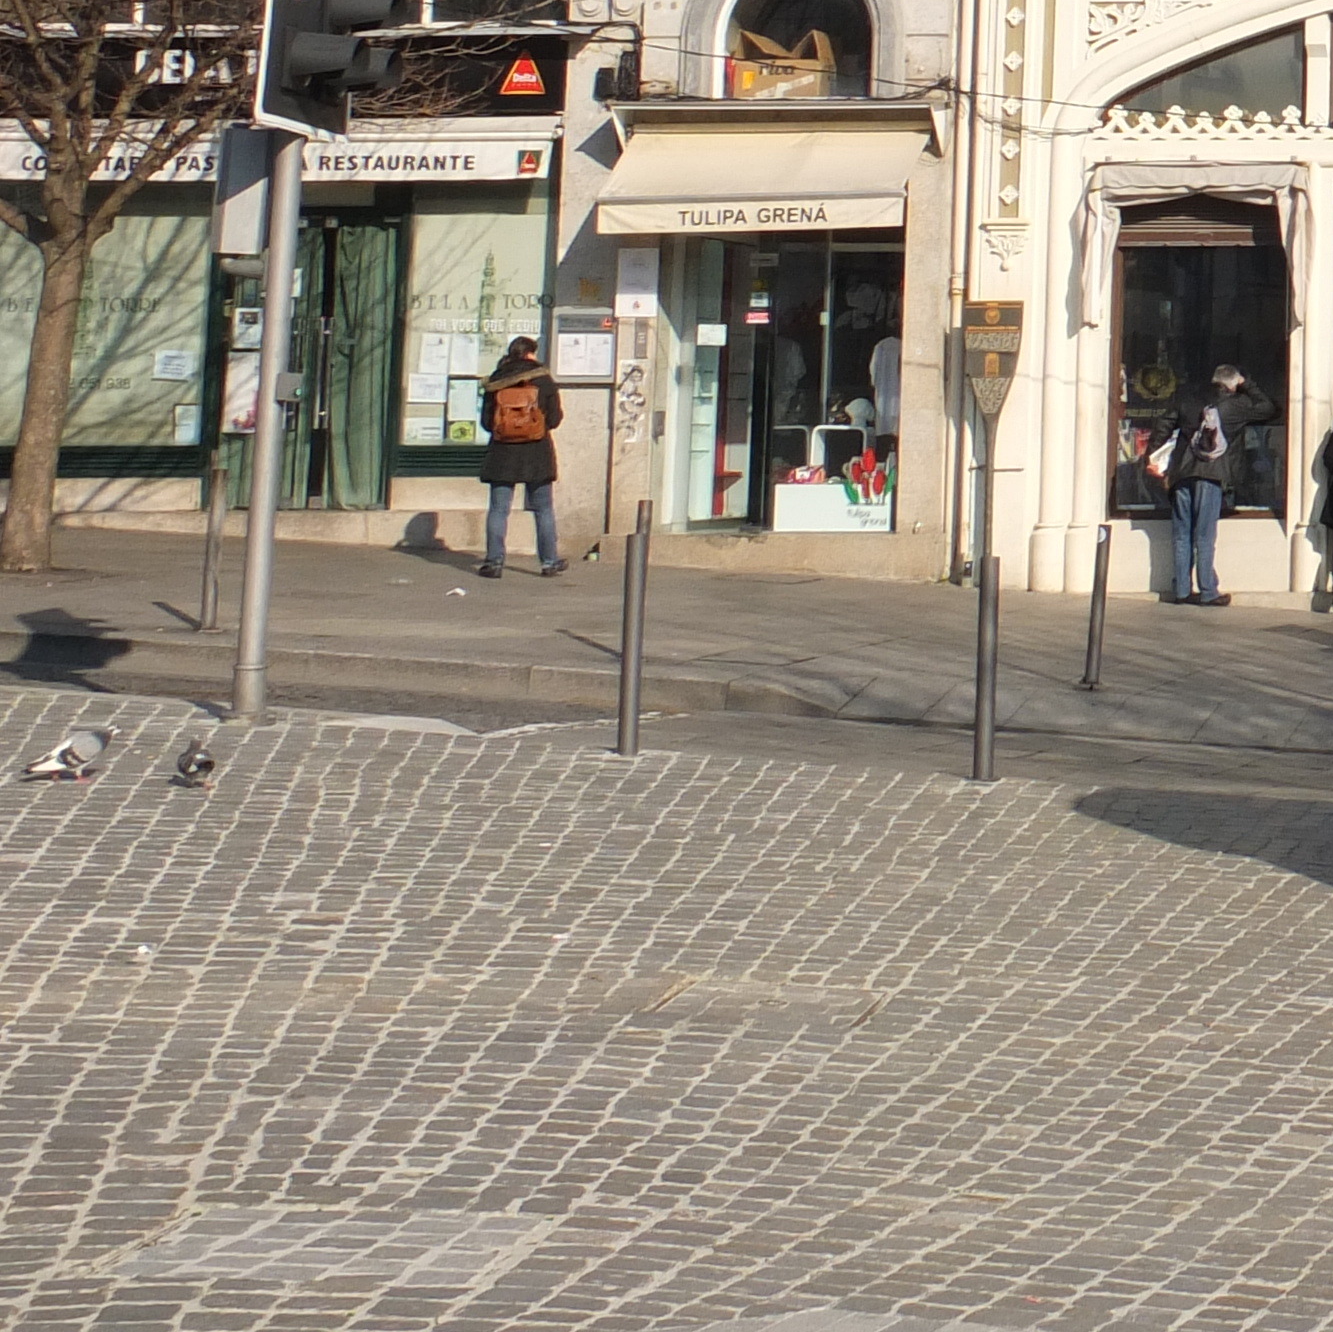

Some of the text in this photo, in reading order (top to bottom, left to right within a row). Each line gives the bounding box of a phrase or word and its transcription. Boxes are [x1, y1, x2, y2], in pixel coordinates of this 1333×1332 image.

[318, 154, 476, 172] RESTAURANTE
[678, 202, 828, 227] TULIPA GRENÁ
